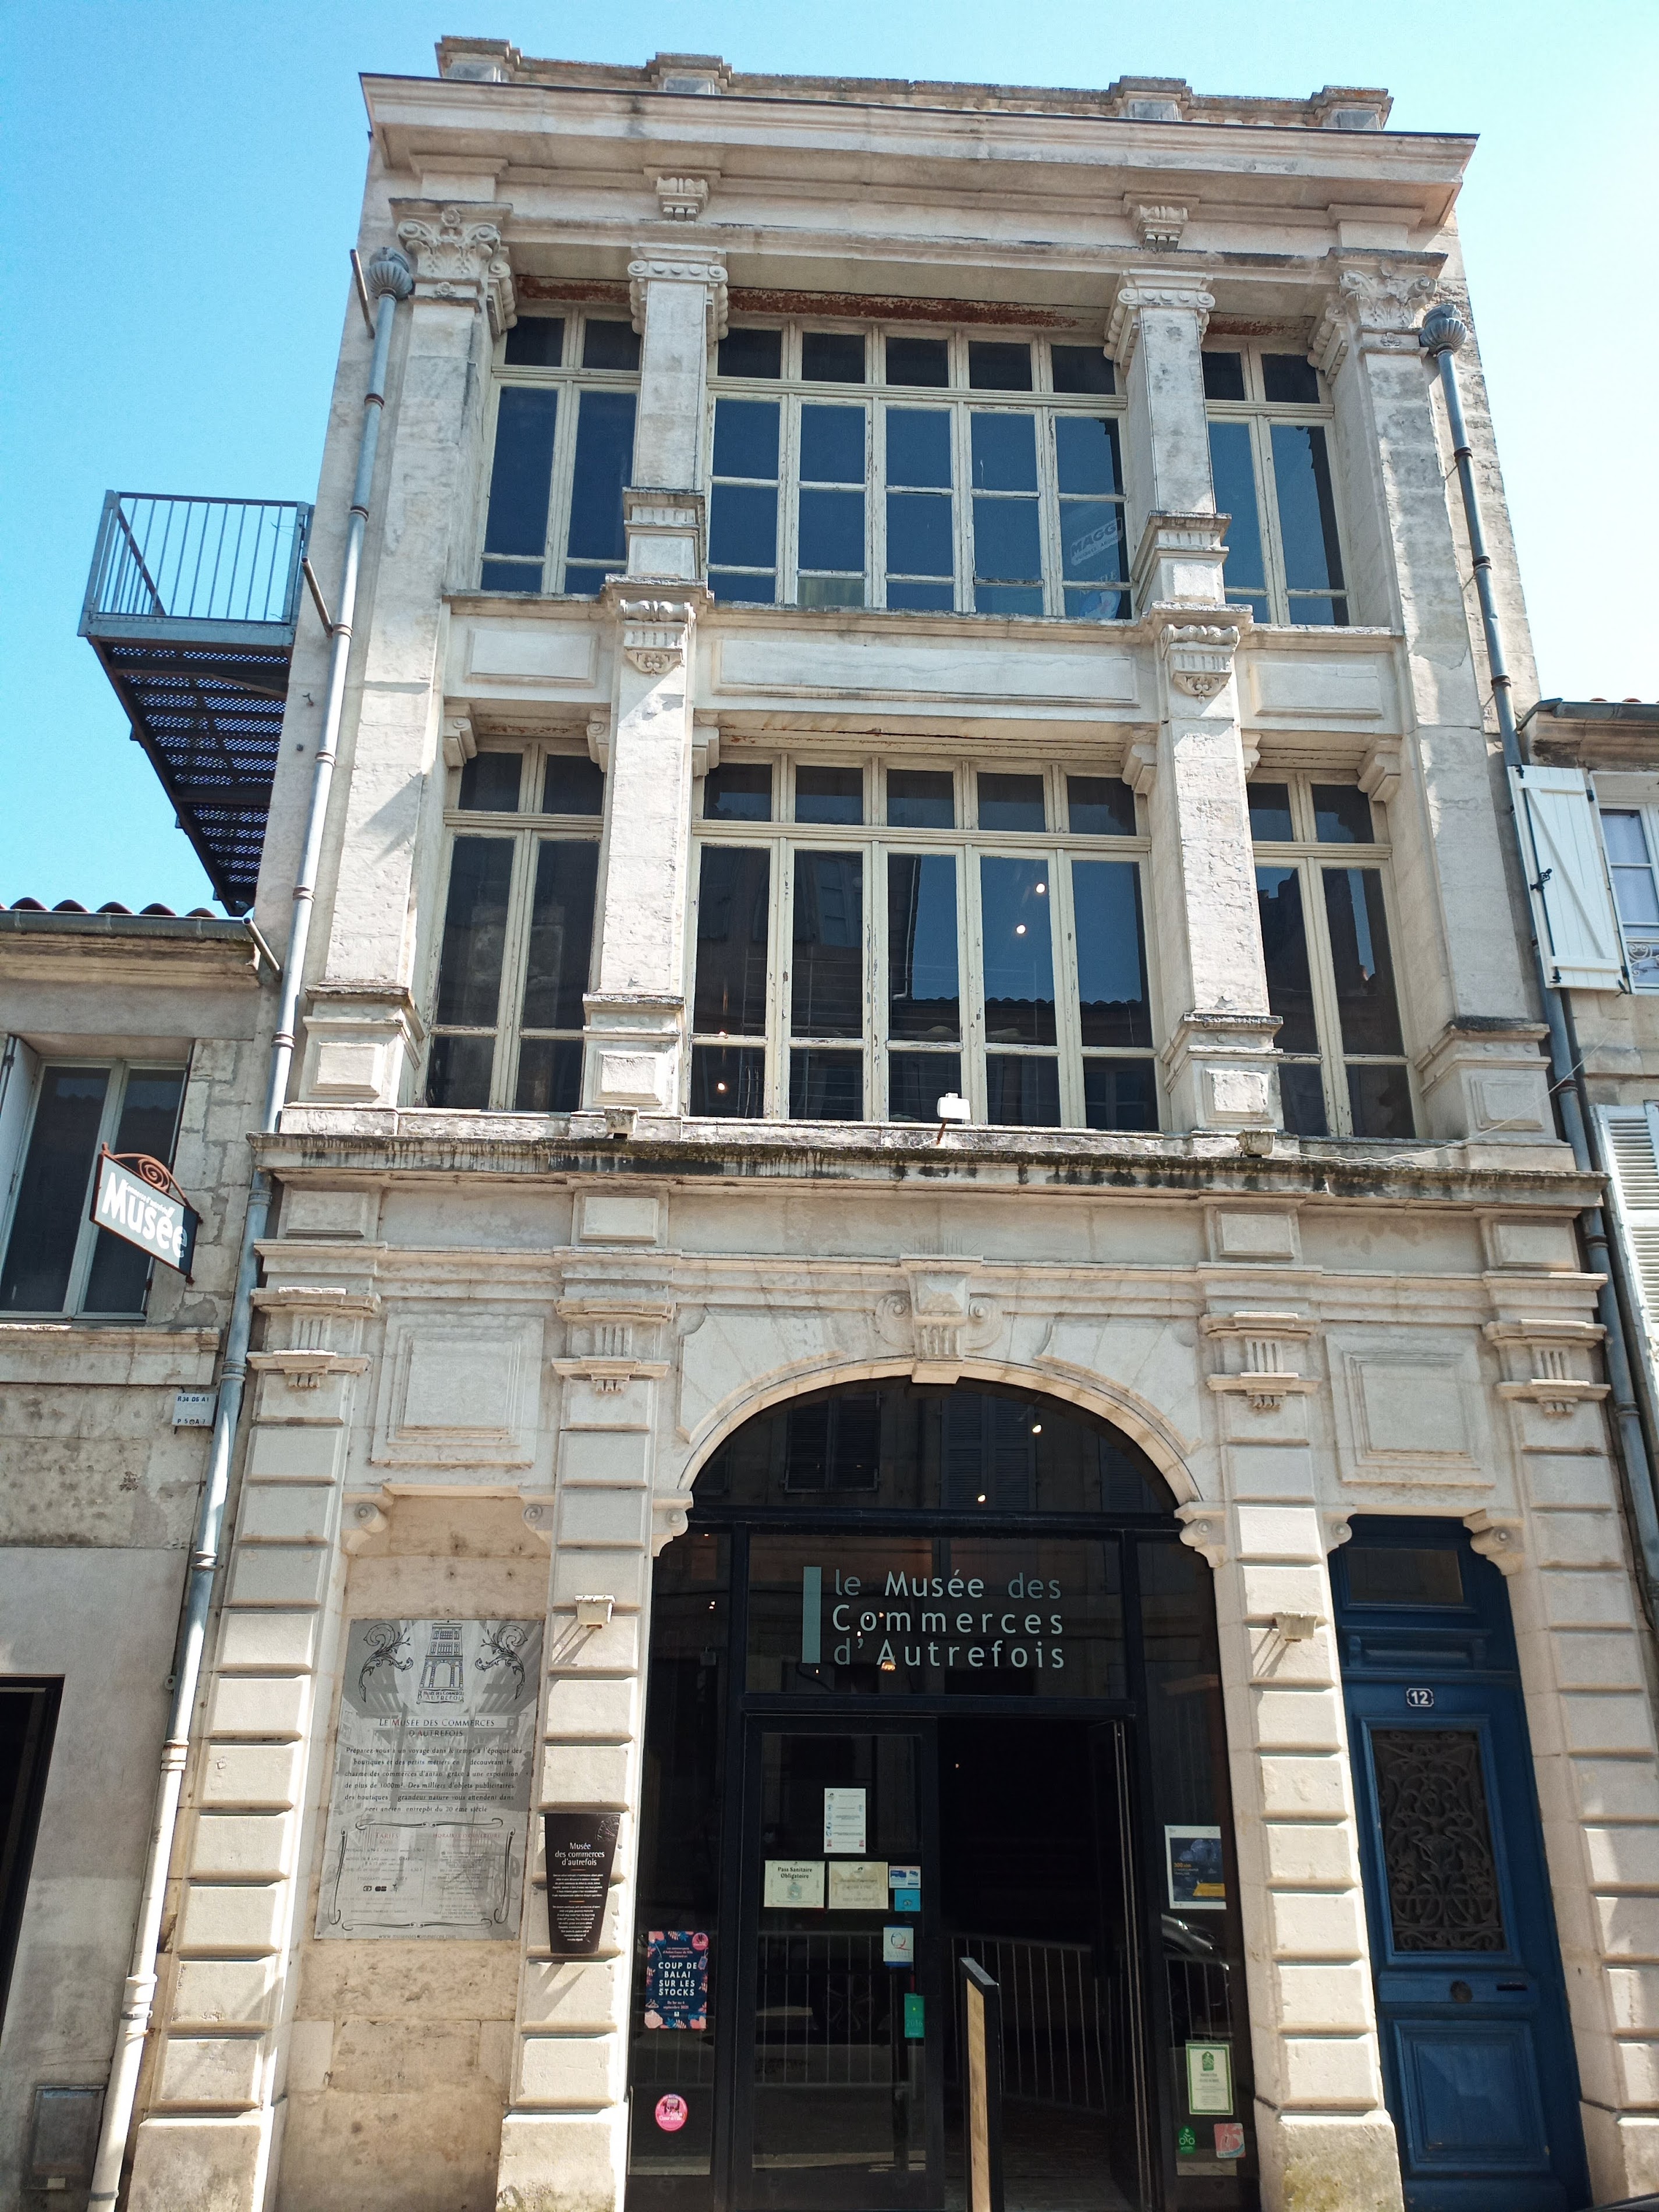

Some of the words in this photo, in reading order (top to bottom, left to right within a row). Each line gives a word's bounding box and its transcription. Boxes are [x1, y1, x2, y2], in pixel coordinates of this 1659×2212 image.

[101, 1172, 187, 1258] Musée
[835, 1569, 862, 1596] le
[884, 1569, 985, 1598] Musée
[1008, 1572, 1062, 1600] des
[832, 1604, 1064, 1635] Commerces
[1410, 1690, 1429, 1704] 12
[448, 1782, 473, 1790] d'objets
[554, 1850, 566, 1858] des
[561, 1857, 597, 1866] d'autrefois
[664, 1970, 690, 1979] BALAI
[658, 1979, 676, 1987] SUR
